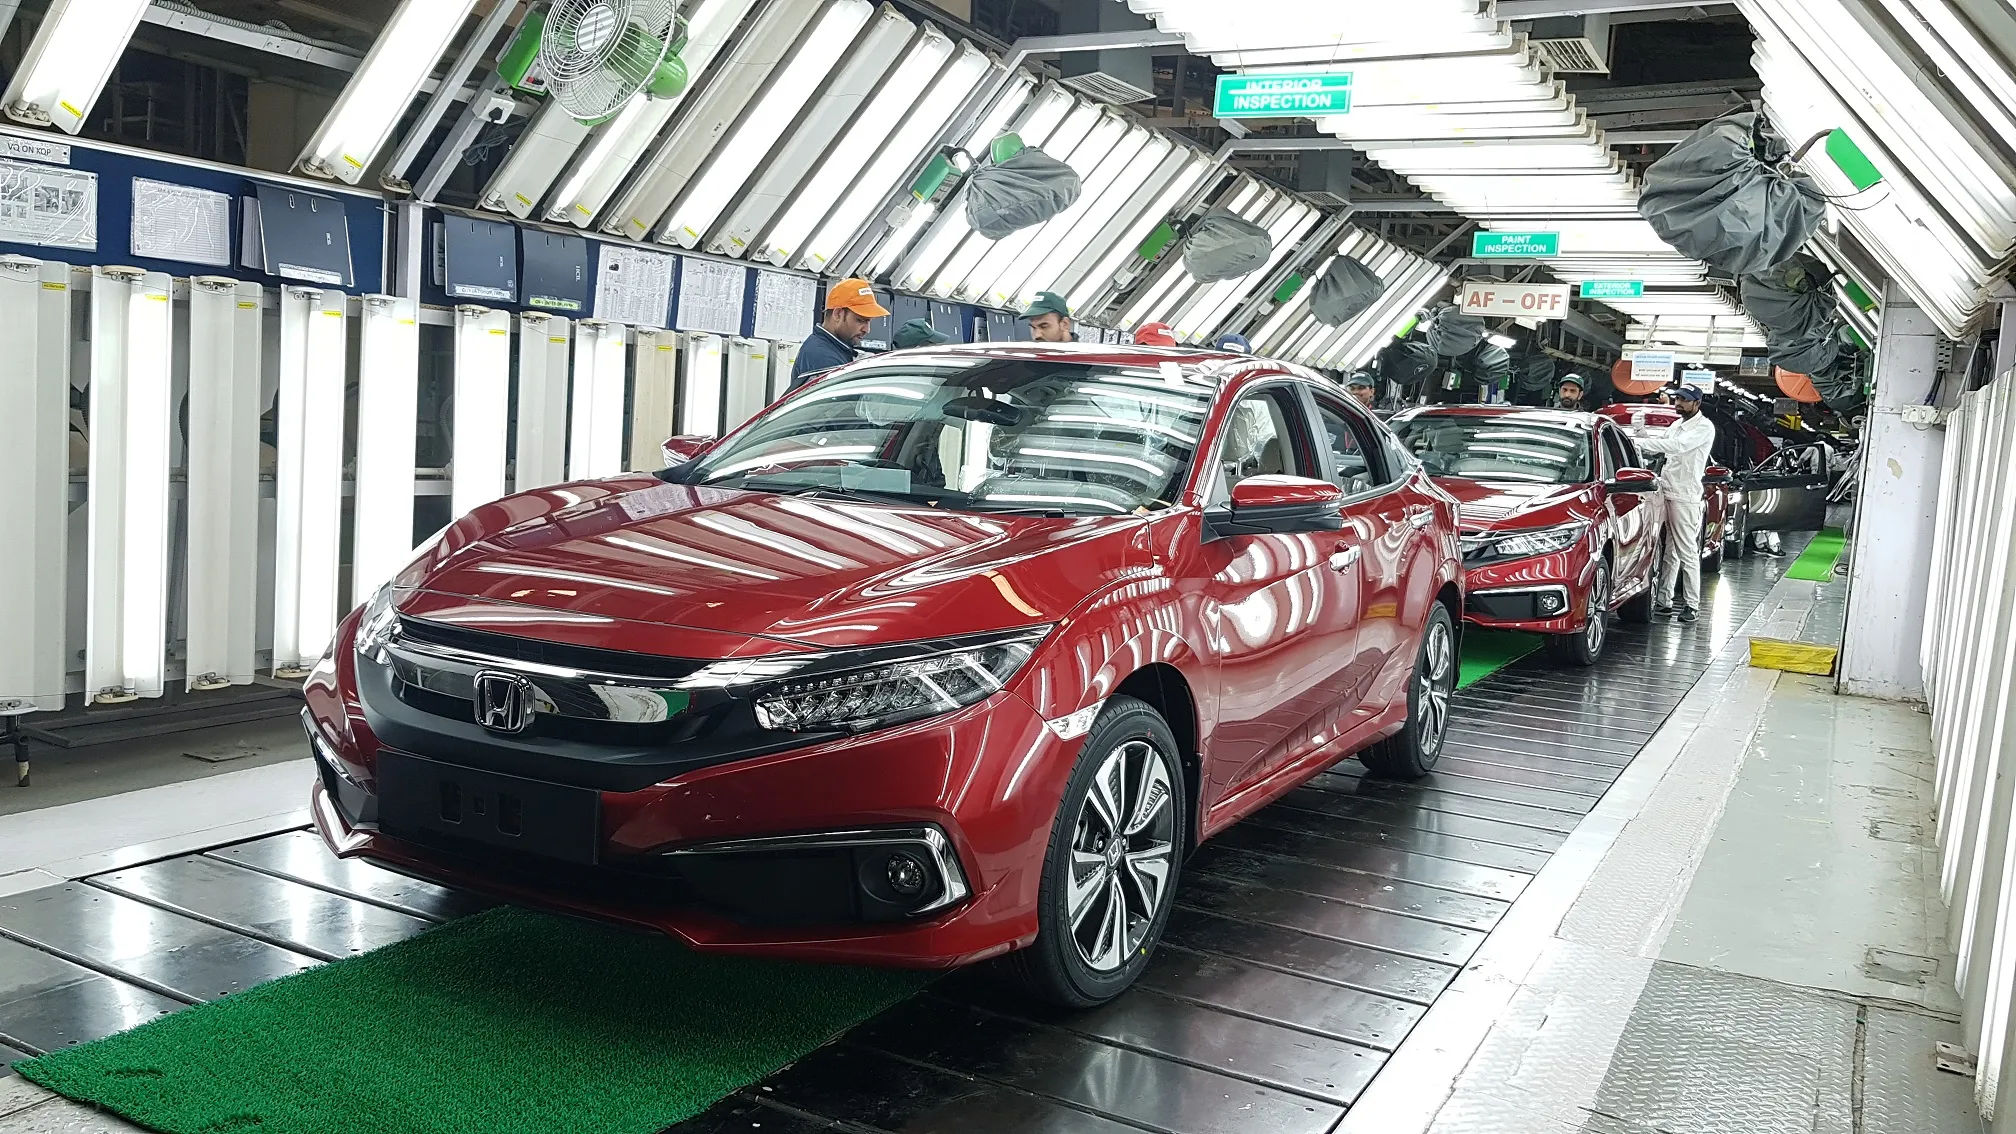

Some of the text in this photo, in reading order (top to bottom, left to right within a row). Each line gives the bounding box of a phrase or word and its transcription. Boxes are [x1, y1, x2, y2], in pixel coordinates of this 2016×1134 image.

[1246, 79, 1322, 91] INTERIOR
[1234, 93, 1331, 109] INSPECTION
[22, 145, 34, 153] ON
[1502, 235, 1531, 244] PAINT
[1485, 243, 1546, 253] INSPECTION
[1467, 291, 1495, 308] AF
[1520, 292, 1562, 310] OFF
